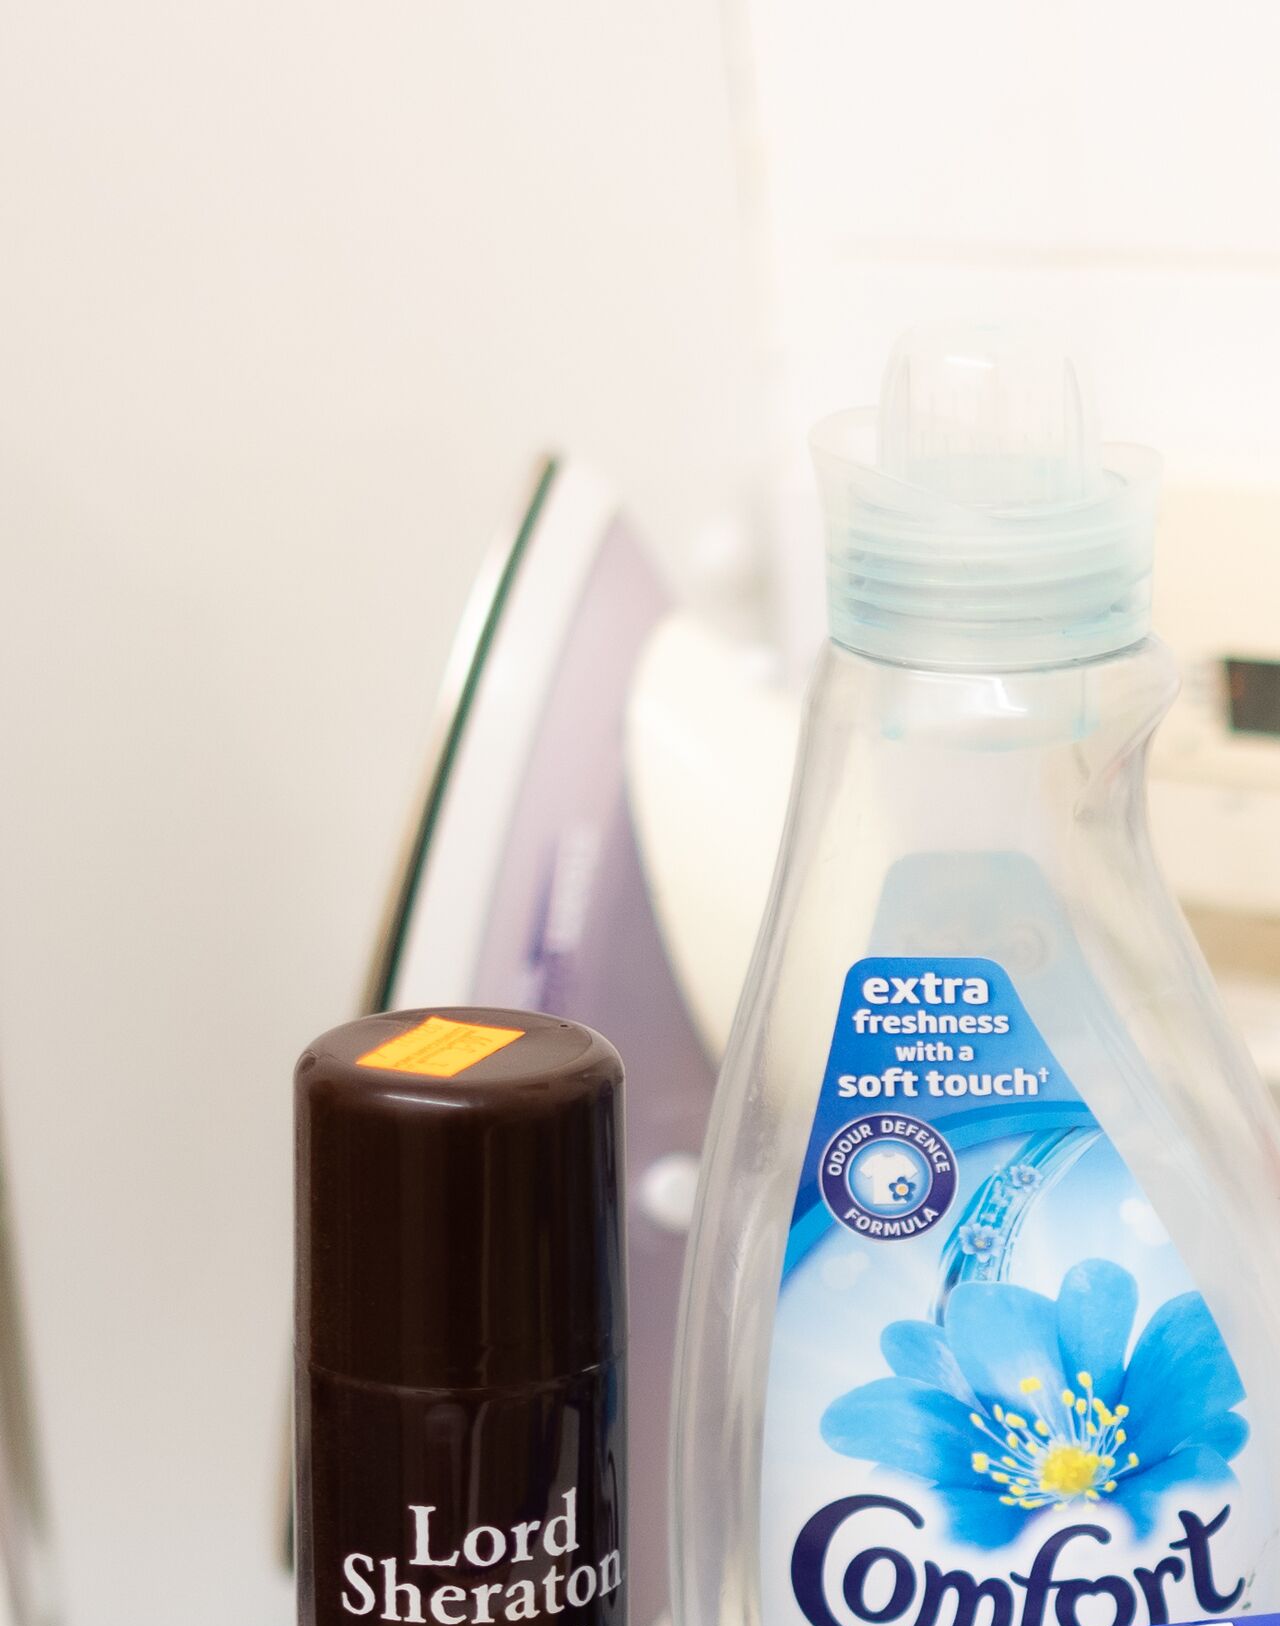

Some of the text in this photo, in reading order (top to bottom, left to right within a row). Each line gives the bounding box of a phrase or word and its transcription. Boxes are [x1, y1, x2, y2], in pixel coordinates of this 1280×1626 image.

[862, 972, 989, 1005] extra
[852, 1009, 1010, 1034] freshness
[895, 1041, 974, 1062] with a
[838, 1067, 919, 1098] soft
[828, 1119, 951, 1177] ODOUR DEFENCE
[844, 1205, 939, 1237] FORMULA
[408, 1486, 580, 1567] Lord
[341, 1549, 623, 1625] Sheraton
